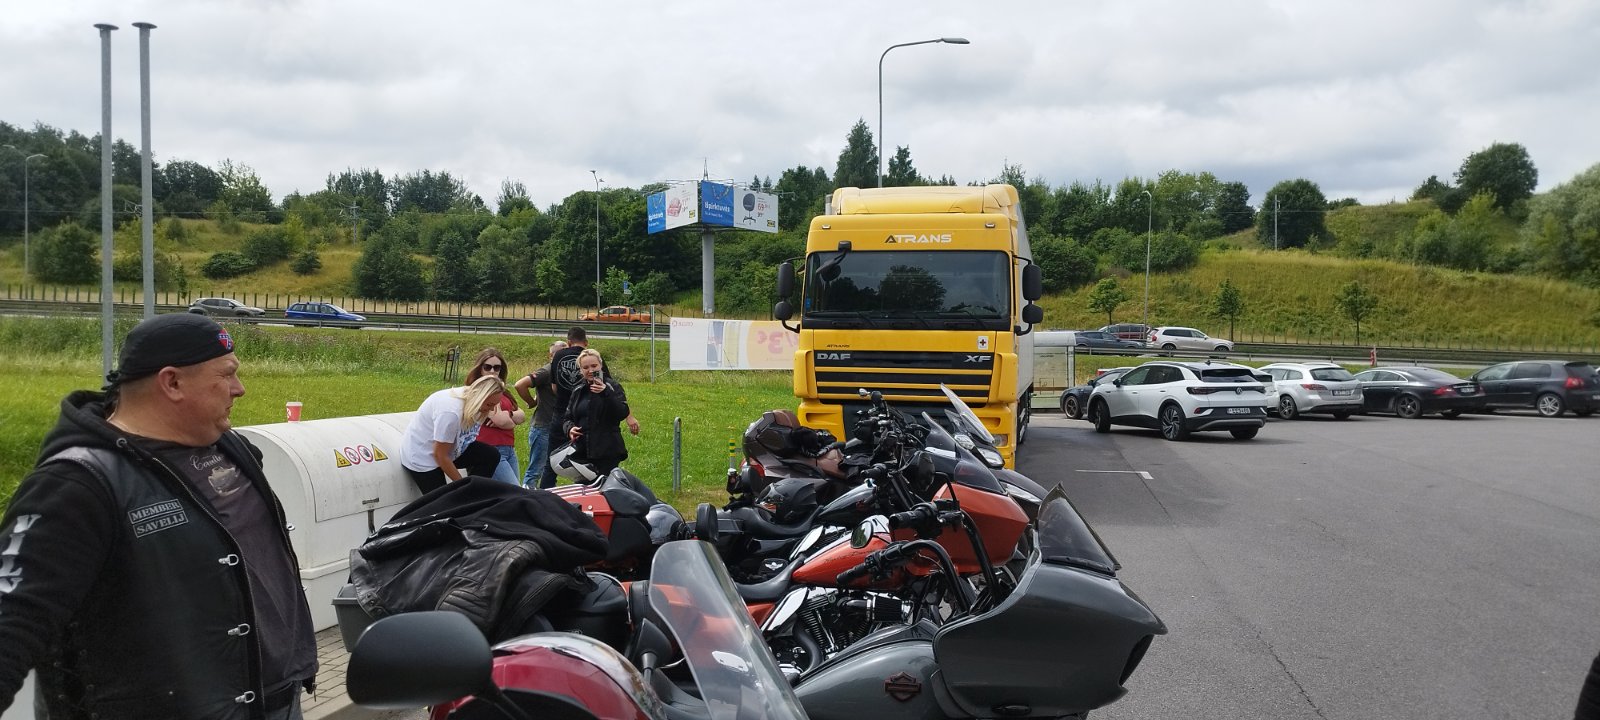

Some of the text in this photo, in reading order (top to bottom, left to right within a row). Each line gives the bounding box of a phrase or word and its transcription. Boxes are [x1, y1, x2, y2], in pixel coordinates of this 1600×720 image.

[884, 234, 953, 244] ATRANS
[816, 352, 851, 360] DAF
[963, 355, 992, 363] XF
[131, 501, 181, 521] MEMBER
[136, 513, 186, 535] SAVELIJ
